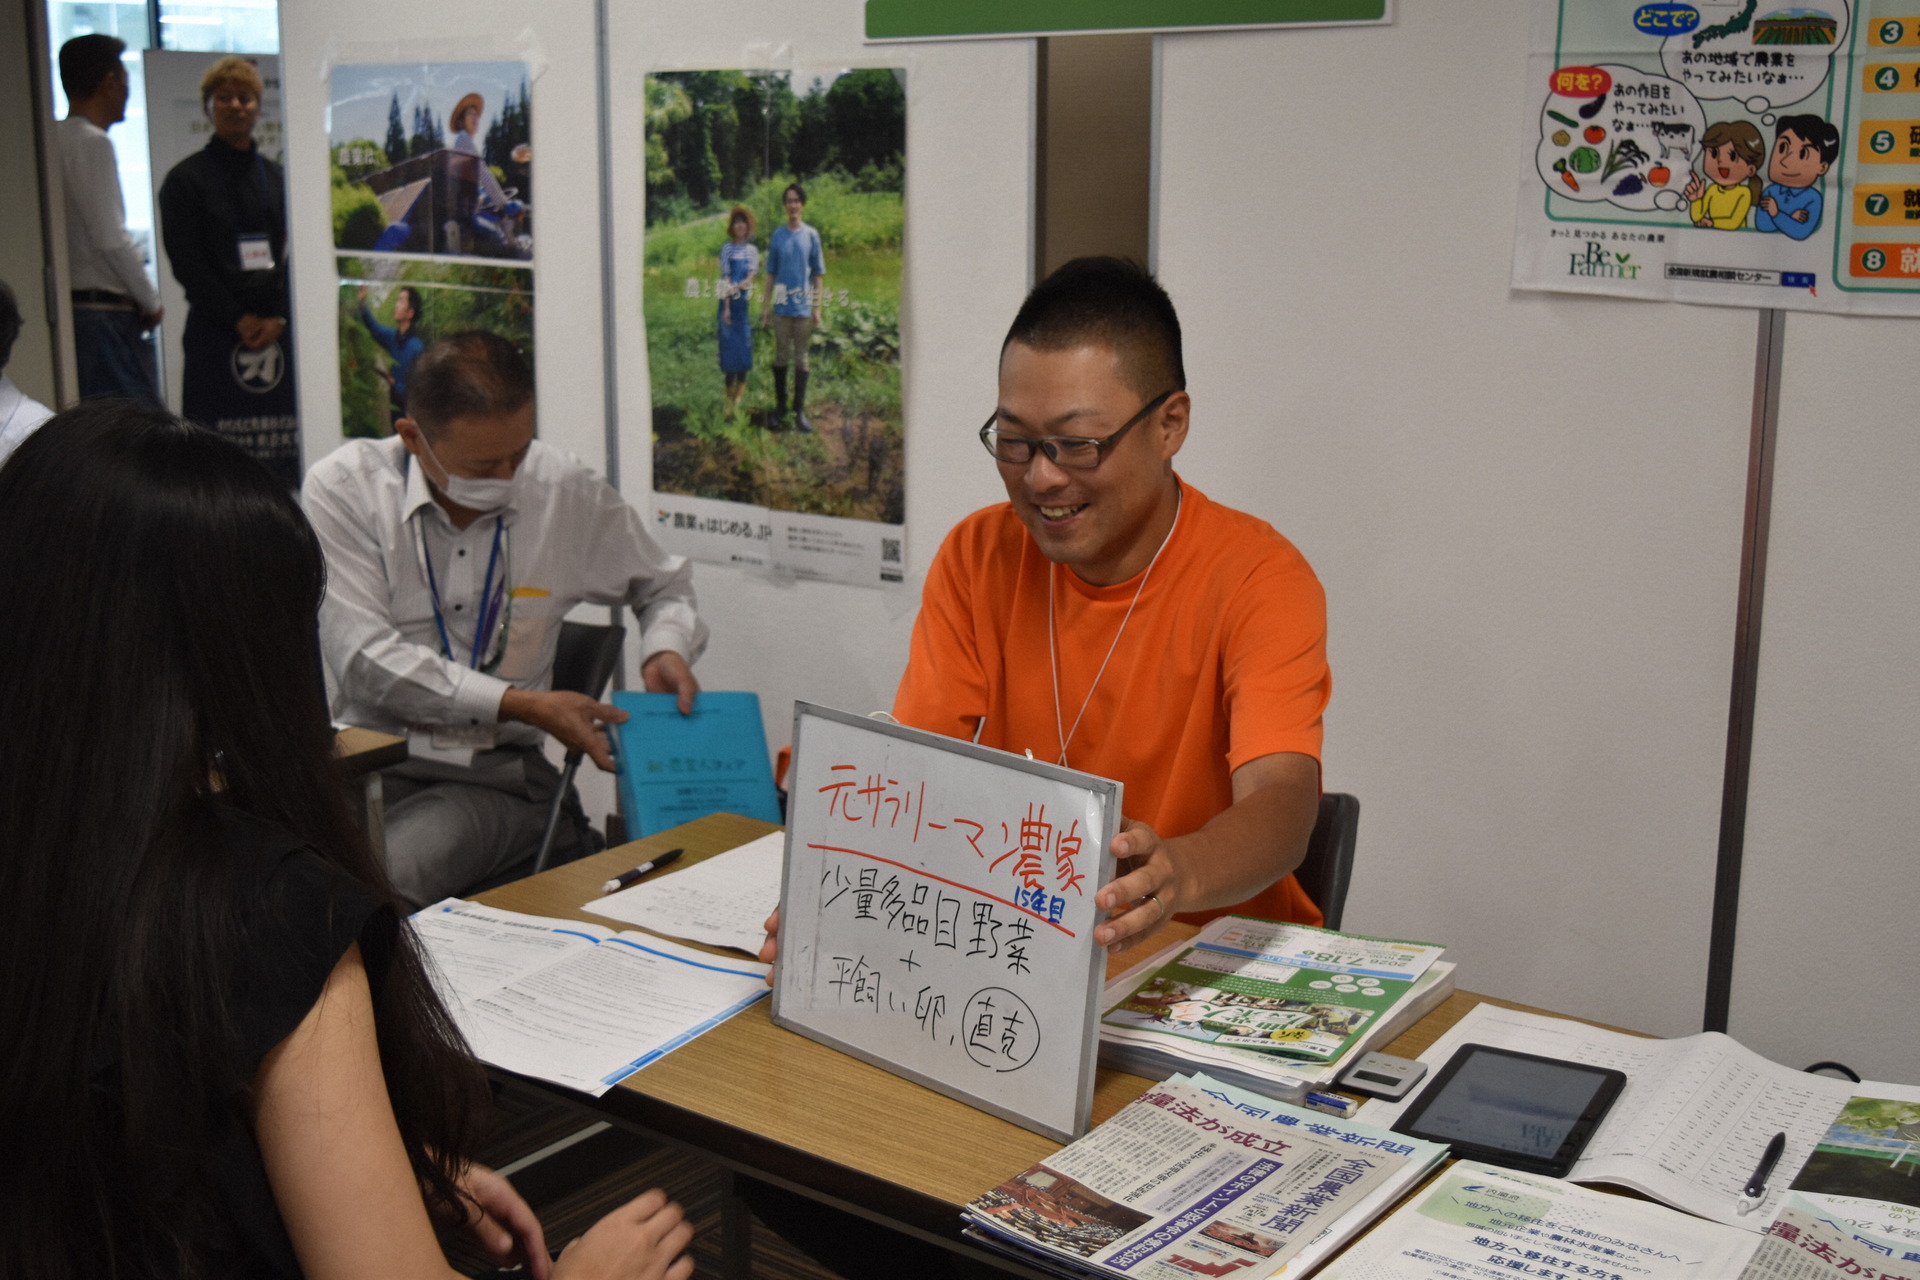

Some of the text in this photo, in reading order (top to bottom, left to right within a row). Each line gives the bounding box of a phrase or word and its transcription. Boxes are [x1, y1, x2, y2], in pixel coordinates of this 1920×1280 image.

[1636, 7, 1698, 28] どこで?
[1885, 23, 1899, 41] 3
[1681, 51, 1796, 68] あの地域で農業を
[1556, 72, 1603, 91] 何を?
[1880, 70, 1895, 87] 4
[1613, 83, 1671, 99] あの作目を
[1613, 101, 1684, 116] やってみたい
[1874, 133, 1890, 151] 5
[1870, 197, 1884, 213] 7
[1586, 241, 1610, 264] Be
[1867, 251, 1881, 269] 8
[1568, 253, 1642, 281] Farmer
[818, 764, 1086, 896] 元サラリーマン農家
[1013, 885, 1067, 925] 15年目
[821, 864, 1035, 975] 少量多品目野菜
[1260, 1158, 1377, 1234] 全国農業新聞
[1464, 1200, 1681, 1262] 地方への移住をご検討のみなさんへ
[1767, 1219, 1908, 1280] 糧法が
